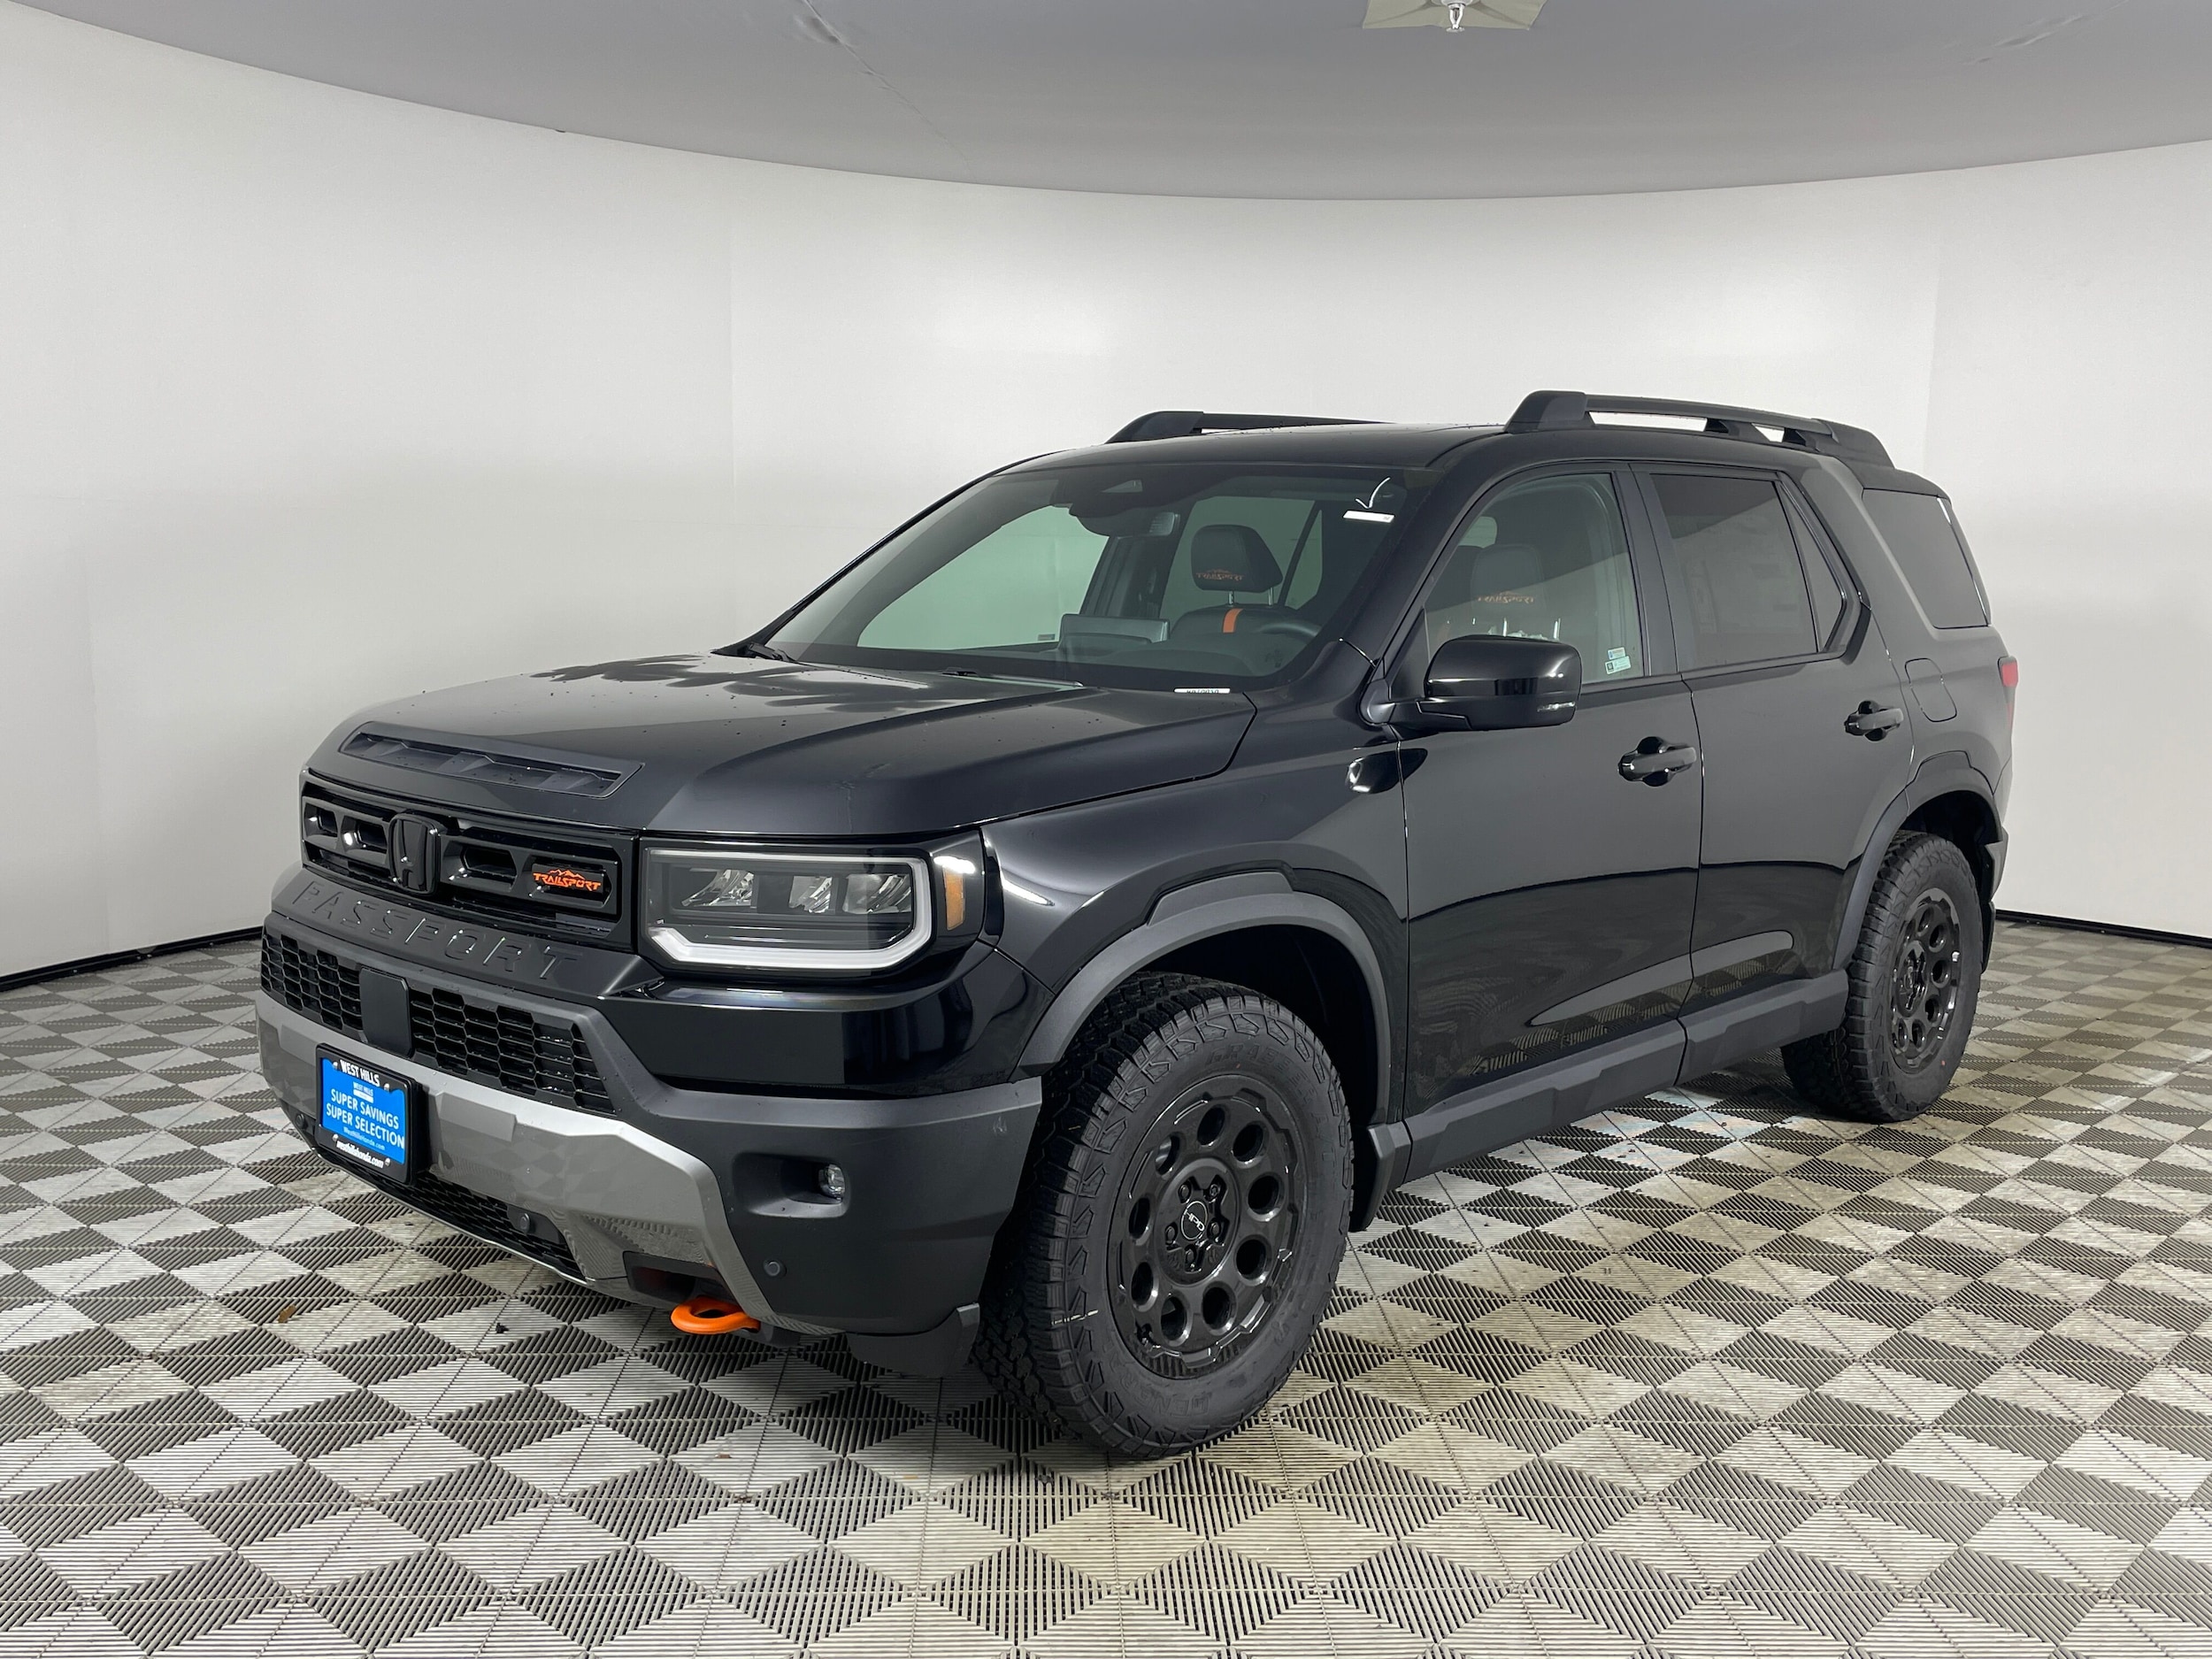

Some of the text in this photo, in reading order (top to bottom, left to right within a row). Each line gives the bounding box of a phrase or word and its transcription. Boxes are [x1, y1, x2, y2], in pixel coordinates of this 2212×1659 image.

[533, 872, 602, 892] TRAILSPORT
[292, 880, 583, 979] PASSPORT
[339, 1059, 380, 1087] WEST HILLS
[326, 1102, 405, 1149] SUPER SELECTION
[331, 1088, 400, 1130] SUPER SAVINGS
[1186, 1211, 1205, 1232] HPD
